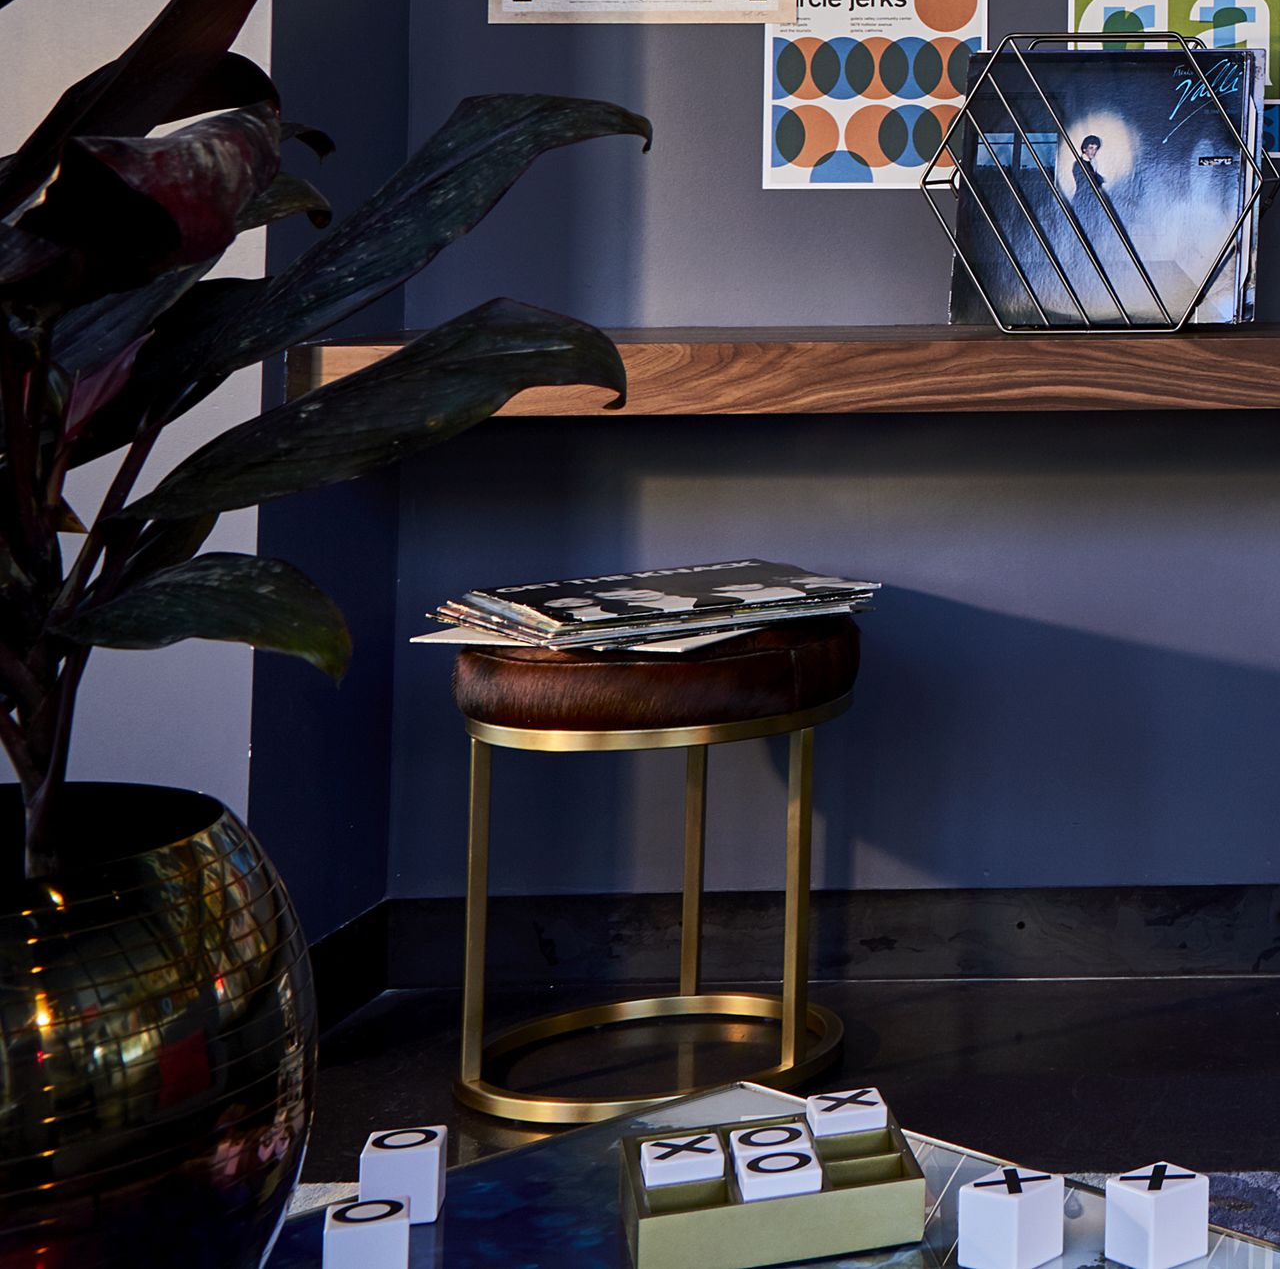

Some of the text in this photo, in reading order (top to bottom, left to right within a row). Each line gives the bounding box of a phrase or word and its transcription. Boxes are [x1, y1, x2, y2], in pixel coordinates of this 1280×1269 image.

[495, 561, 761, 594] GET THE KNACK
